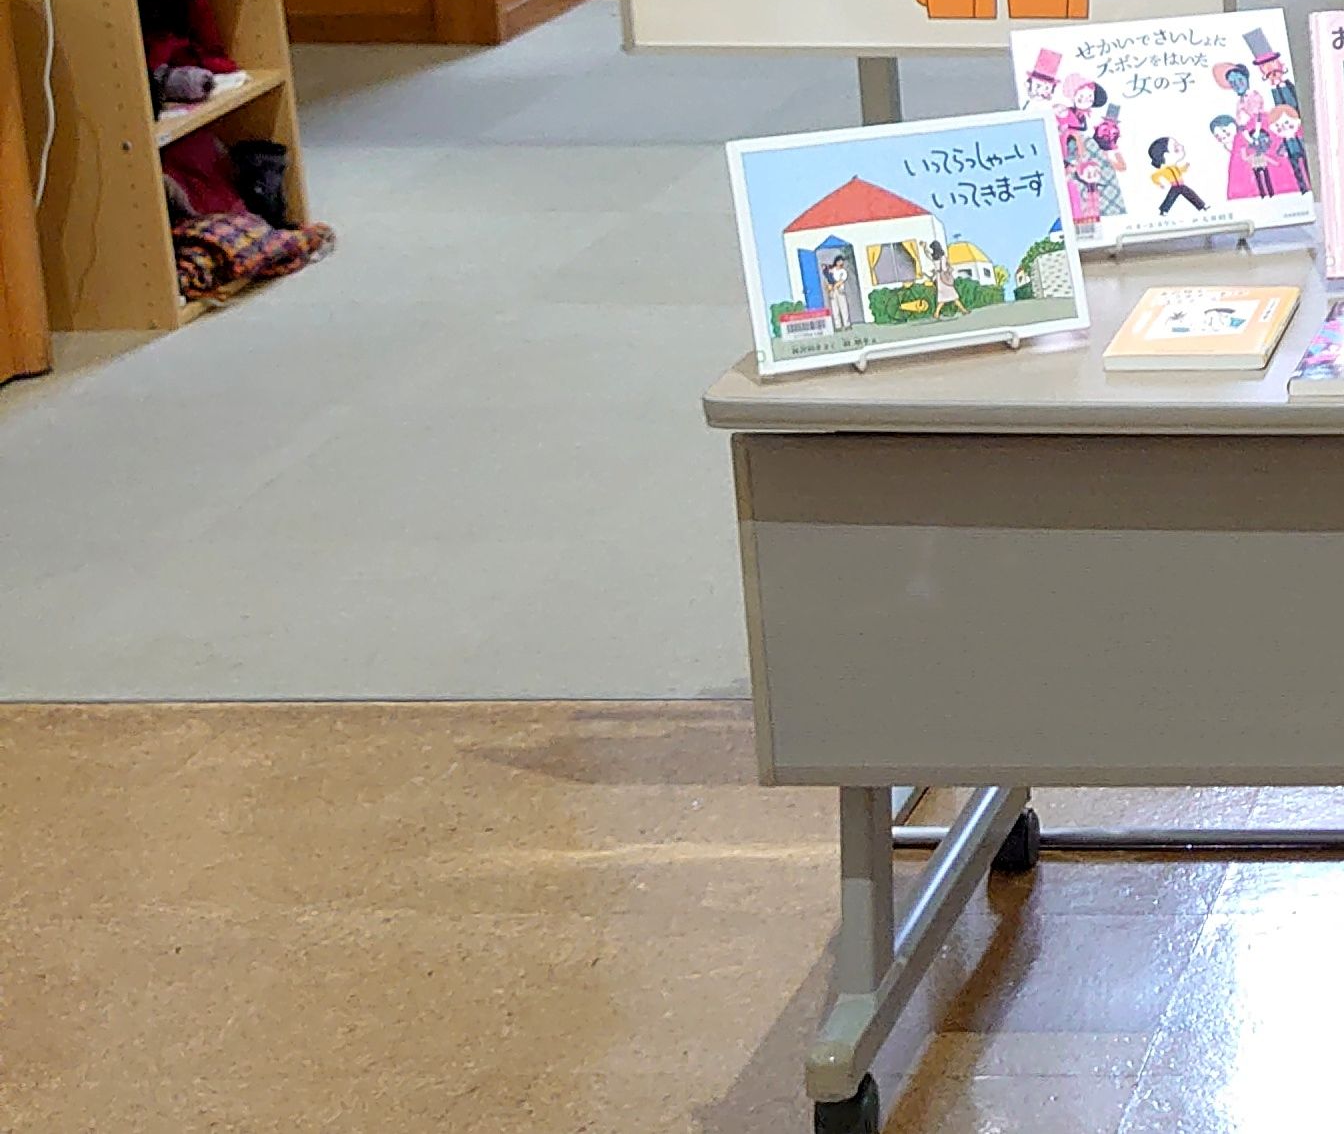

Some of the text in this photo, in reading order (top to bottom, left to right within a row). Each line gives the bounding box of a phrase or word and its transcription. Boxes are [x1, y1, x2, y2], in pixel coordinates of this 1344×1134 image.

[1075, 28, 1227, 60] せかいでさいしょに
[1096, 52, 1209, 78] ズボンをはいた
[1122, 71, 1196, 98] 女の子
[903, 142, 1038, 176] いってらっしゃーい
[931, 170, 1045, 209] いってきまーす
